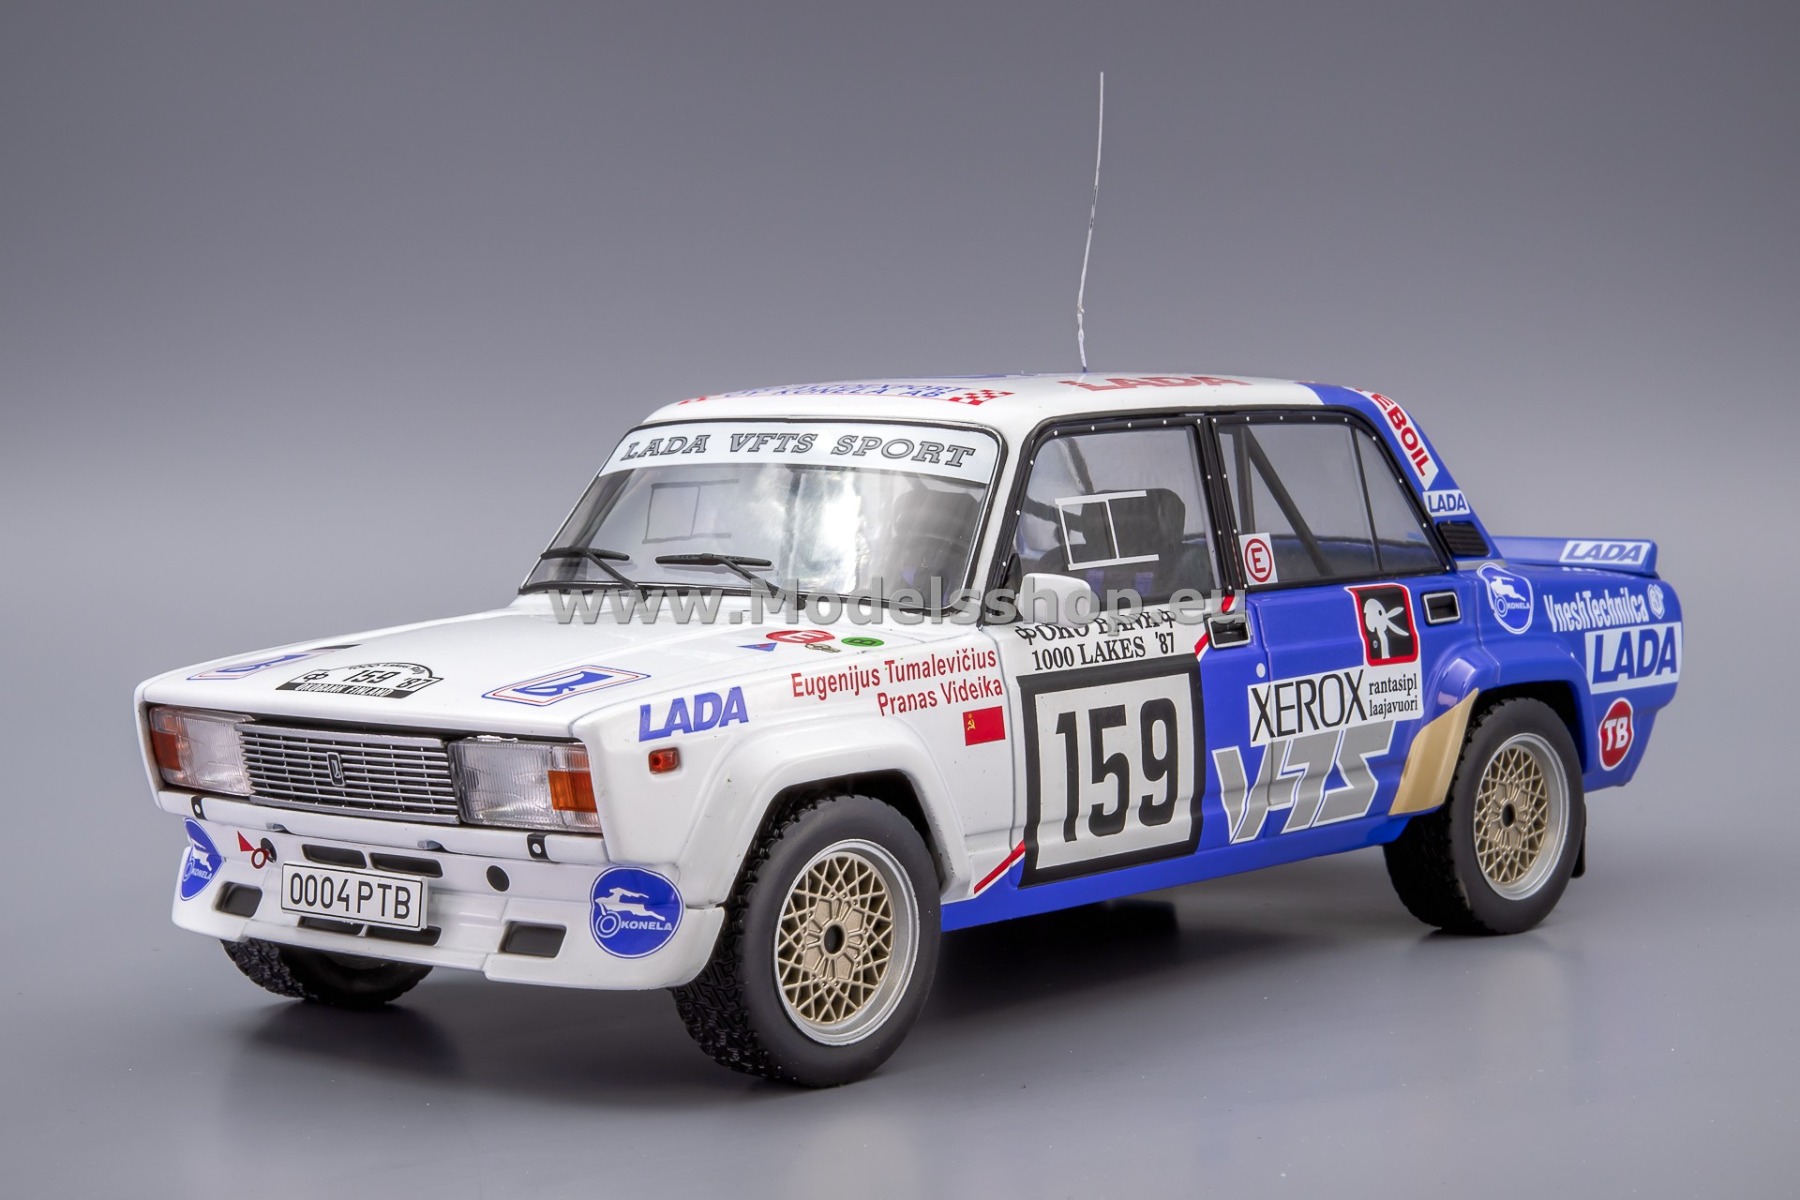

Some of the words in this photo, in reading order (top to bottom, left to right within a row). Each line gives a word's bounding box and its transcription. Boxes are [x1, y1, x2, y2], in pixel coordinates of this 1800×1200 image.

[1057, 376, 1252, 391] LADA
[620, 434, 711, 461] LADA
[730, 433, 818, 454] VFTS
[831, 435, 975, 468] SPORT
[1428, 493, 1467, 513] LADA
[1251, 547, 1266, 573] E
[1564, 543, 1645, 562] LADA
[1032, 646, 1075, 671] 1000
[1077, 636, 1146, 665] LAKES
[1155, 632, 1175, 655] '87
[1592, 626, 1678, 684] LADA
[342, 669, 401, 684] 159
[791, 664, 881, 701] Eugenijus
[884, 648, 997, 683] Tumalevičius
[639, 685, 749, 742] LADA
[877, 686, 938, 717] Pranas
[941, 676, 1003, 706] Videika
[1251, 669, 1367, 742] XEROX
[1369, 695, 1419, 719] laajavuori
[1604, 716, 1628, 751] TB
[1056, 697, 1179, 843] 159
[621, 920, 673, 931] KONELA
